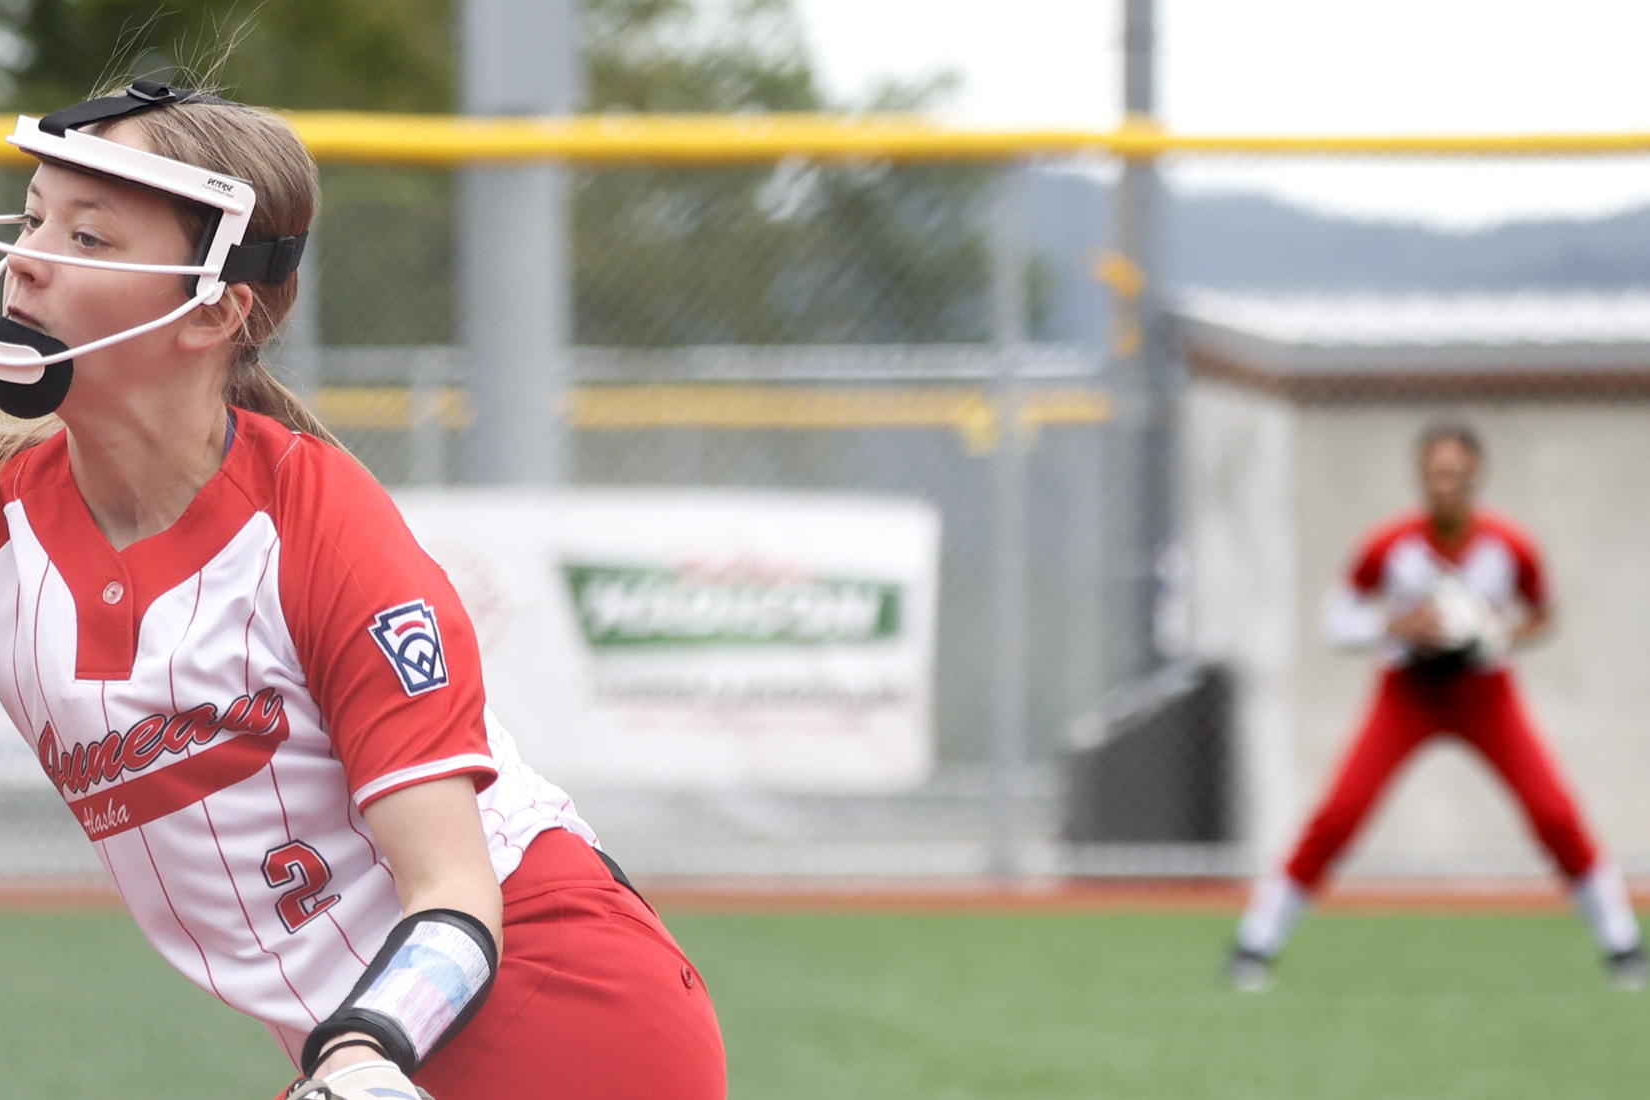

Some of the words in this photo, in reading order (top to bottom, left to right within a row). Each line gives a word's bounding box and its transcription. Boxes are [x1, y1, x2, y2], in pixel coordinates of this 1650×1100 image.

[38, 687, 284, 794] Juneau
[83, 797, 131, 835] Alaska
[260, 839, 342, 935] 2
